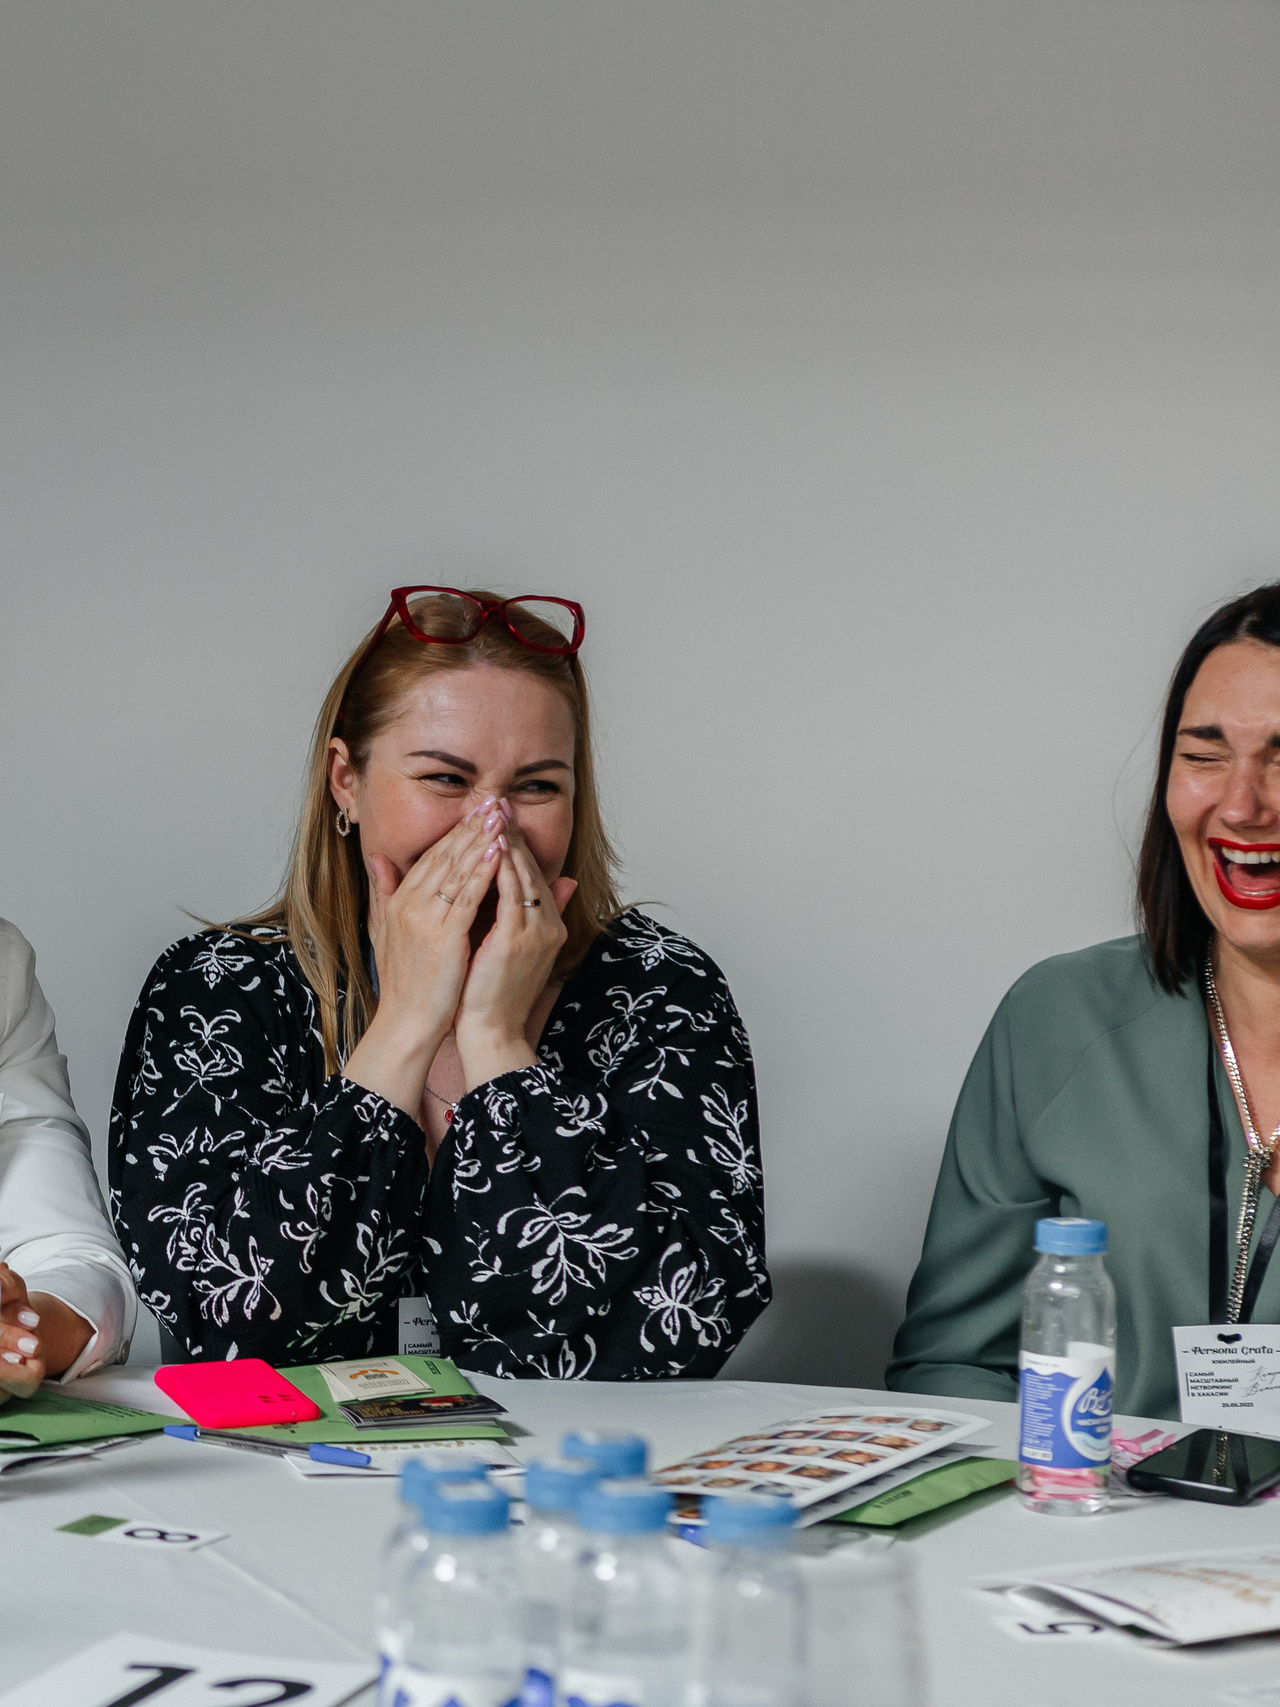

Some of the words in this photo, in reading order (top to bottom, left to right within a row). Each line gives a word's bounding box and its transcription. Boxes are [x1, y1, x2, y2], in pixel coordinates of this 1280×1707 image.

[1191, 1346, 1238, 1355] Persona
[1241, 1346, 1273, 1355] Grata
[124, 1528, 200, 1543] 8
[1018, 1622, 1103, 1634] 5
